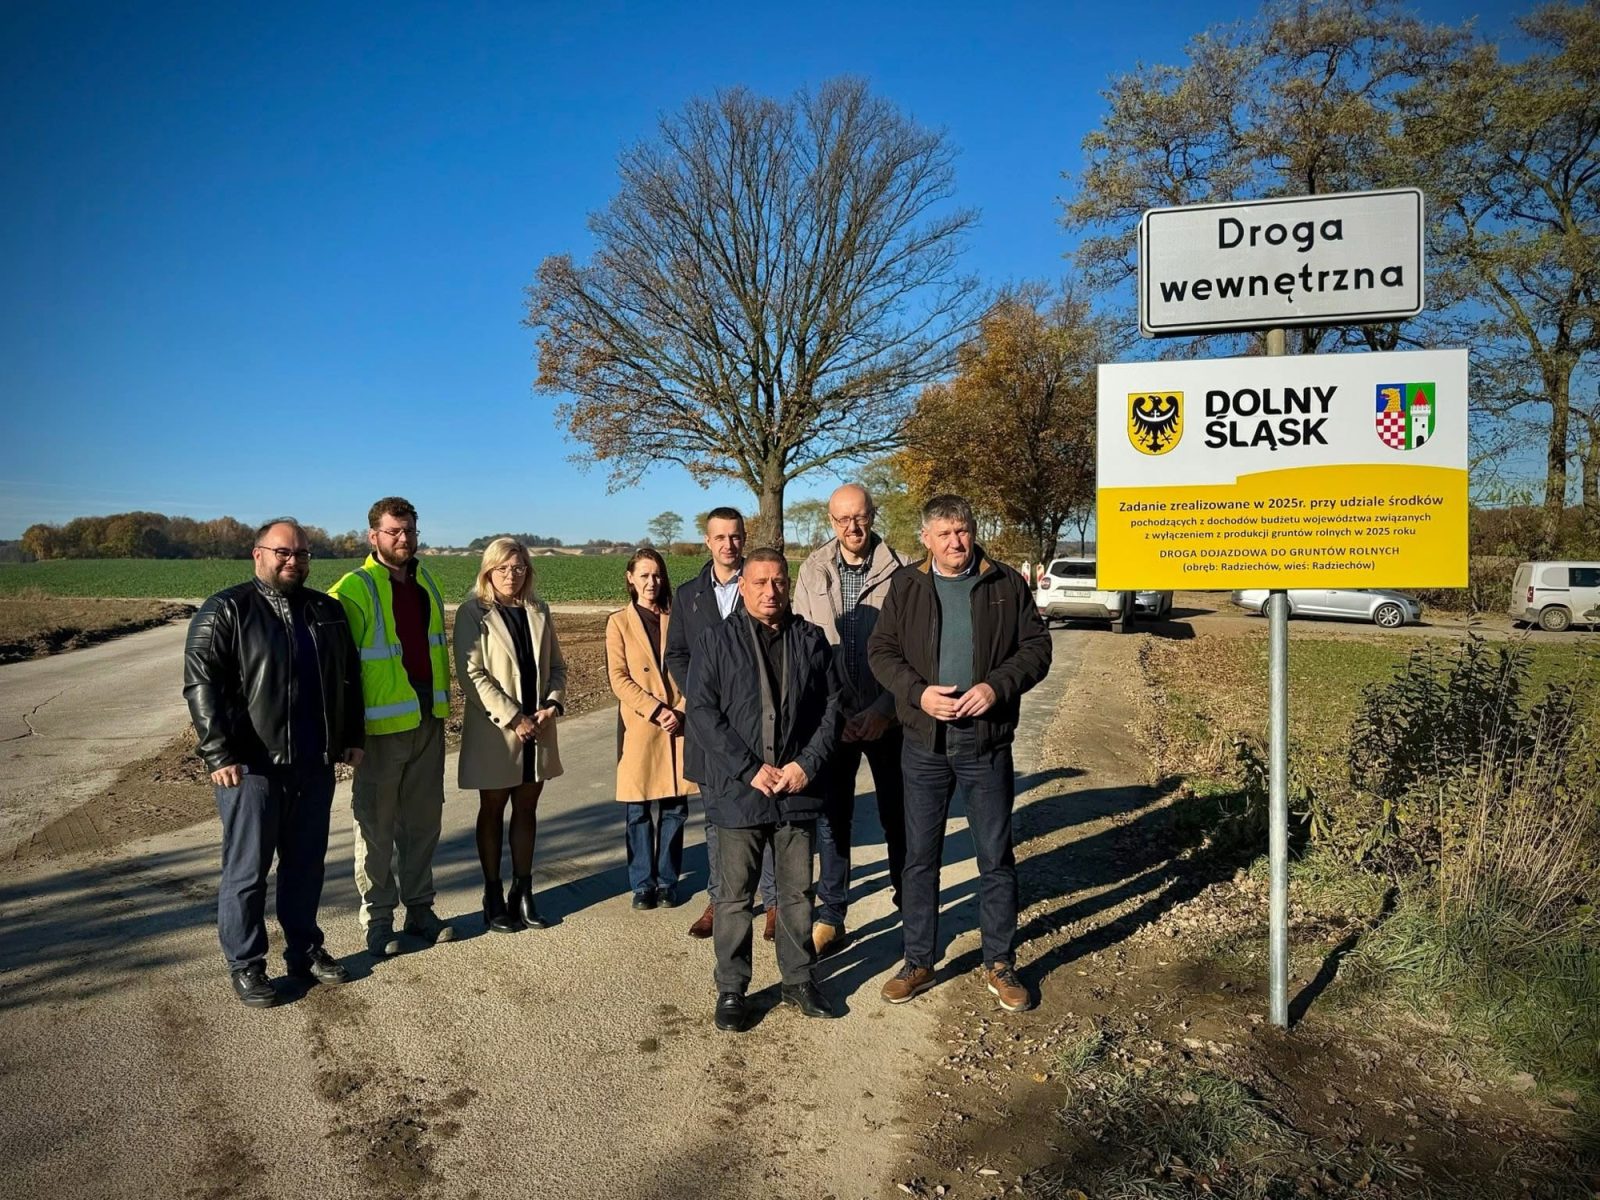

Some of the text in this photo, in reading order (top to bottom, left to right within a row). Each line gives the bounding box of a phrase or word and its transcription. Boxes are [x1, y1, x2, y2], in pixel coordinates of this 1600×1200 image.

[1218, 217, 1344, 253] Droga
[1159, 262, 1404, 304] wewnętrzna
[1205, 385, 1339, 418] DOLNY
[1204, 414, 1329, 452] ŚLĄSK
[1119, 495, 1444, 512] Zadanie zrealizowane w 2025r. przy udziale środków
[1130, 513, 1432, 529] pochodzących z dochodów budżetu województwa związanych
[1144, 527, 1417, 541] z wyłączeniem z produkcji gruntów rolnych w 2025 roku
[1159, 546, 1400, 559] DROGA DOJAZDOWA DO GRUNTÓW ROLNYCH
[1182, 560, 1376, 573] (obręb: Radziechów, wieś: Radziechów)
